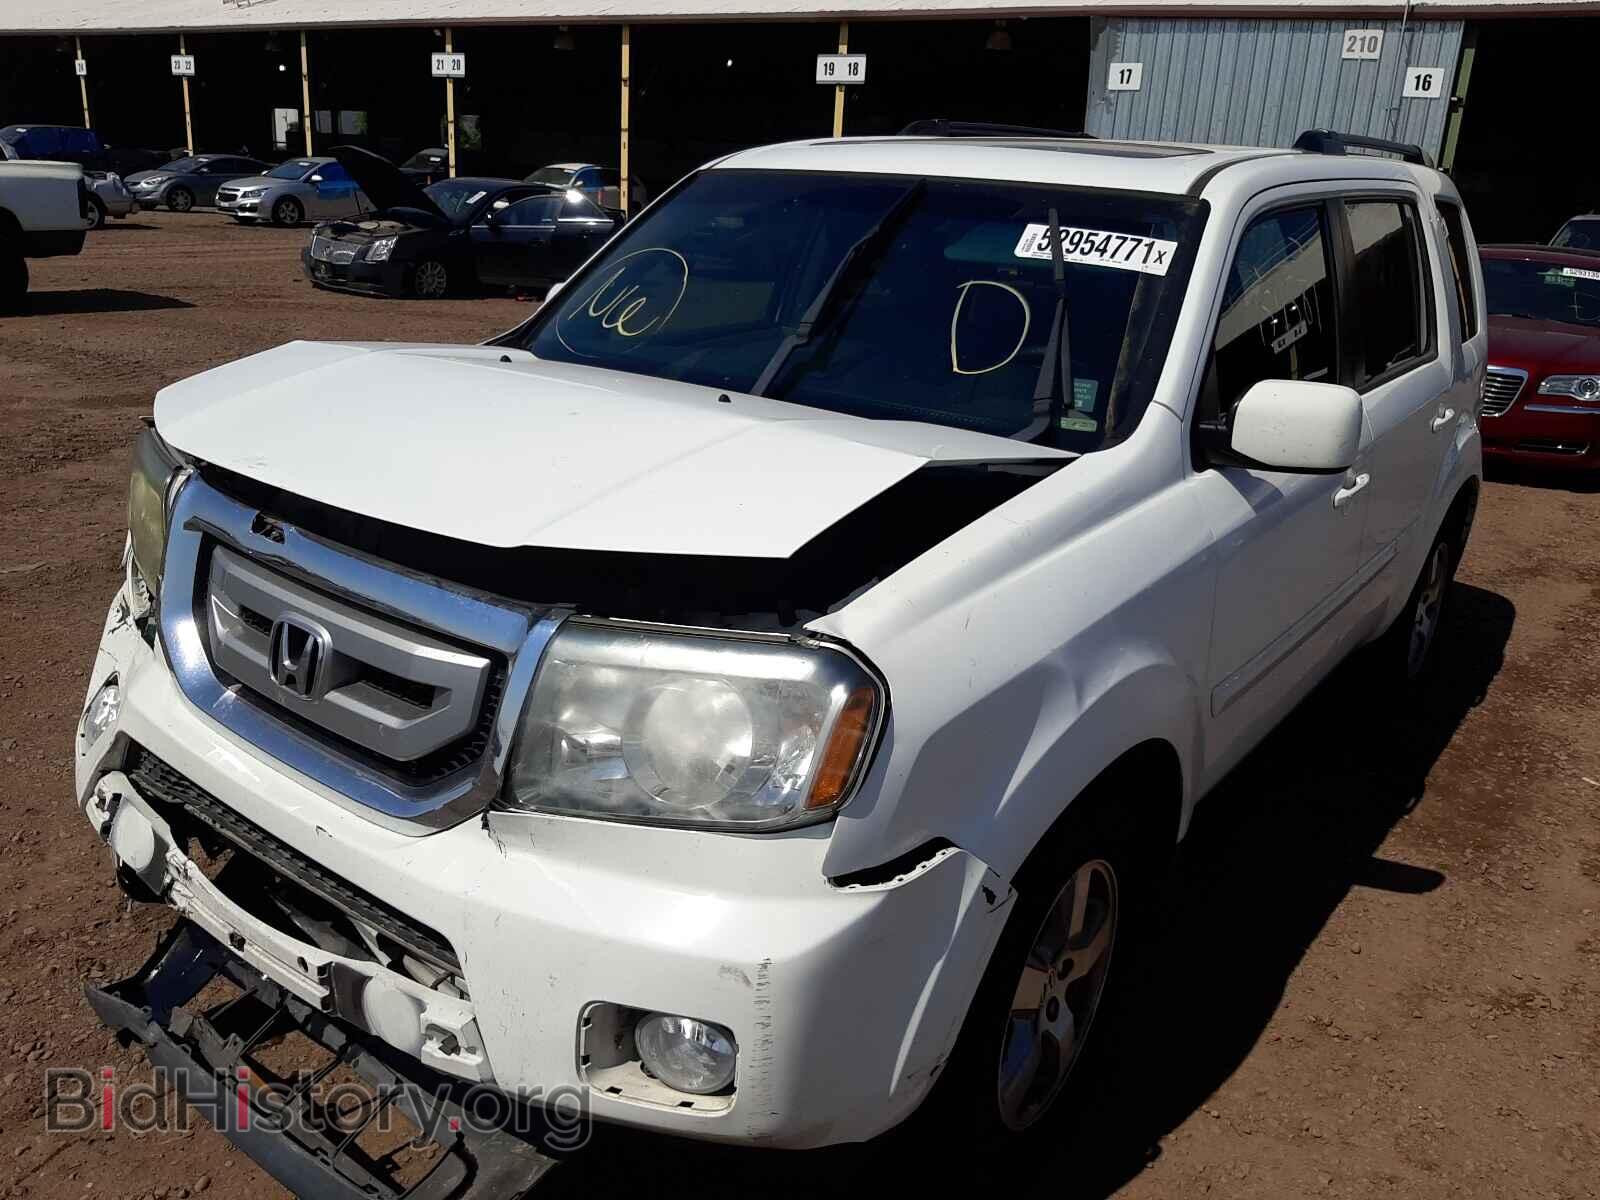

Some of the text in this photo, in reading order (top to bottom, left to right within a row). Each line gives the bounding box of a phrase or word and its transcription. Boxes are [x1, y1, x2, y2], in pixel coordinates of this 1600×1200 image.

[1346, 34, 1379, 54] 210
[436, 58, 461, 71] 21 20
[823, 62, 859, 76] 19 18
[1117, 68, 1133, 85] 17
[1413, 73, 1432, 91] 16
